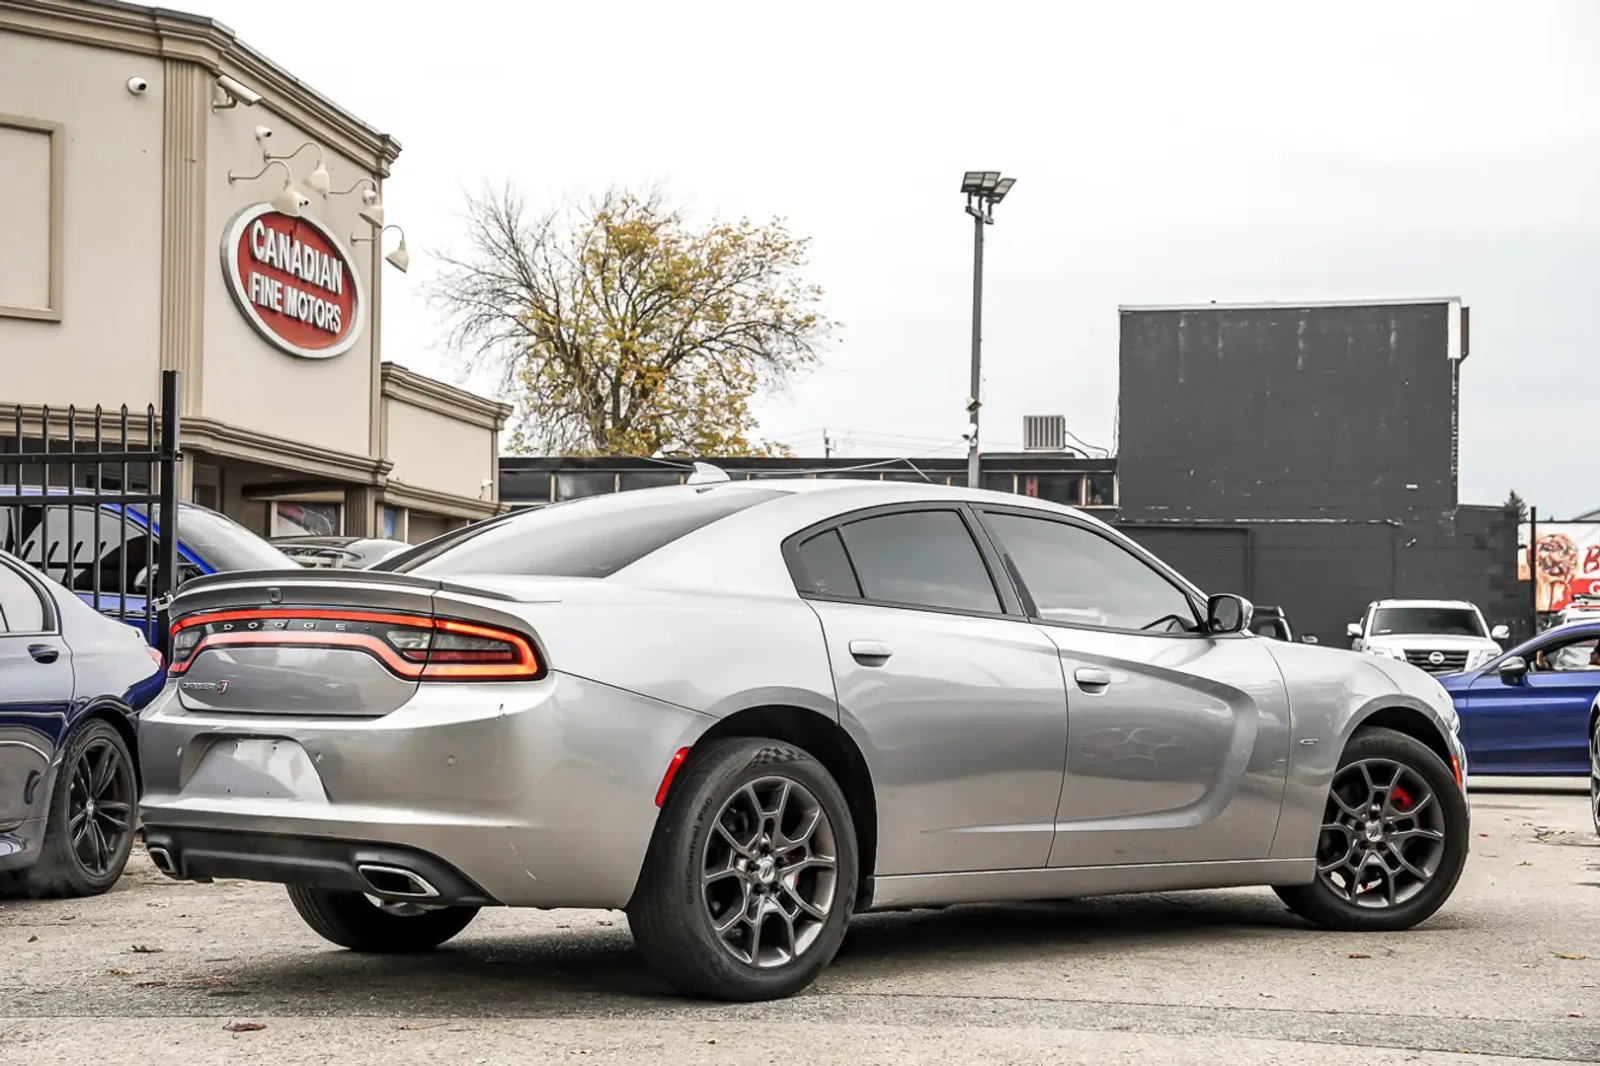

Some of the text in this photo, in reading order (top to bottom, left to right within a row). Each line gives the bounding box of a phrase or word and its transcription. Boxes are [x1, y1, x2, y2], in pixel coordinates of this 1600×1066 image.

[251, 219, 342, 295] CANADIAN
[250, 271, 341, 334] FINE MOTORS
[223, 621, 347, 631] DODGE
